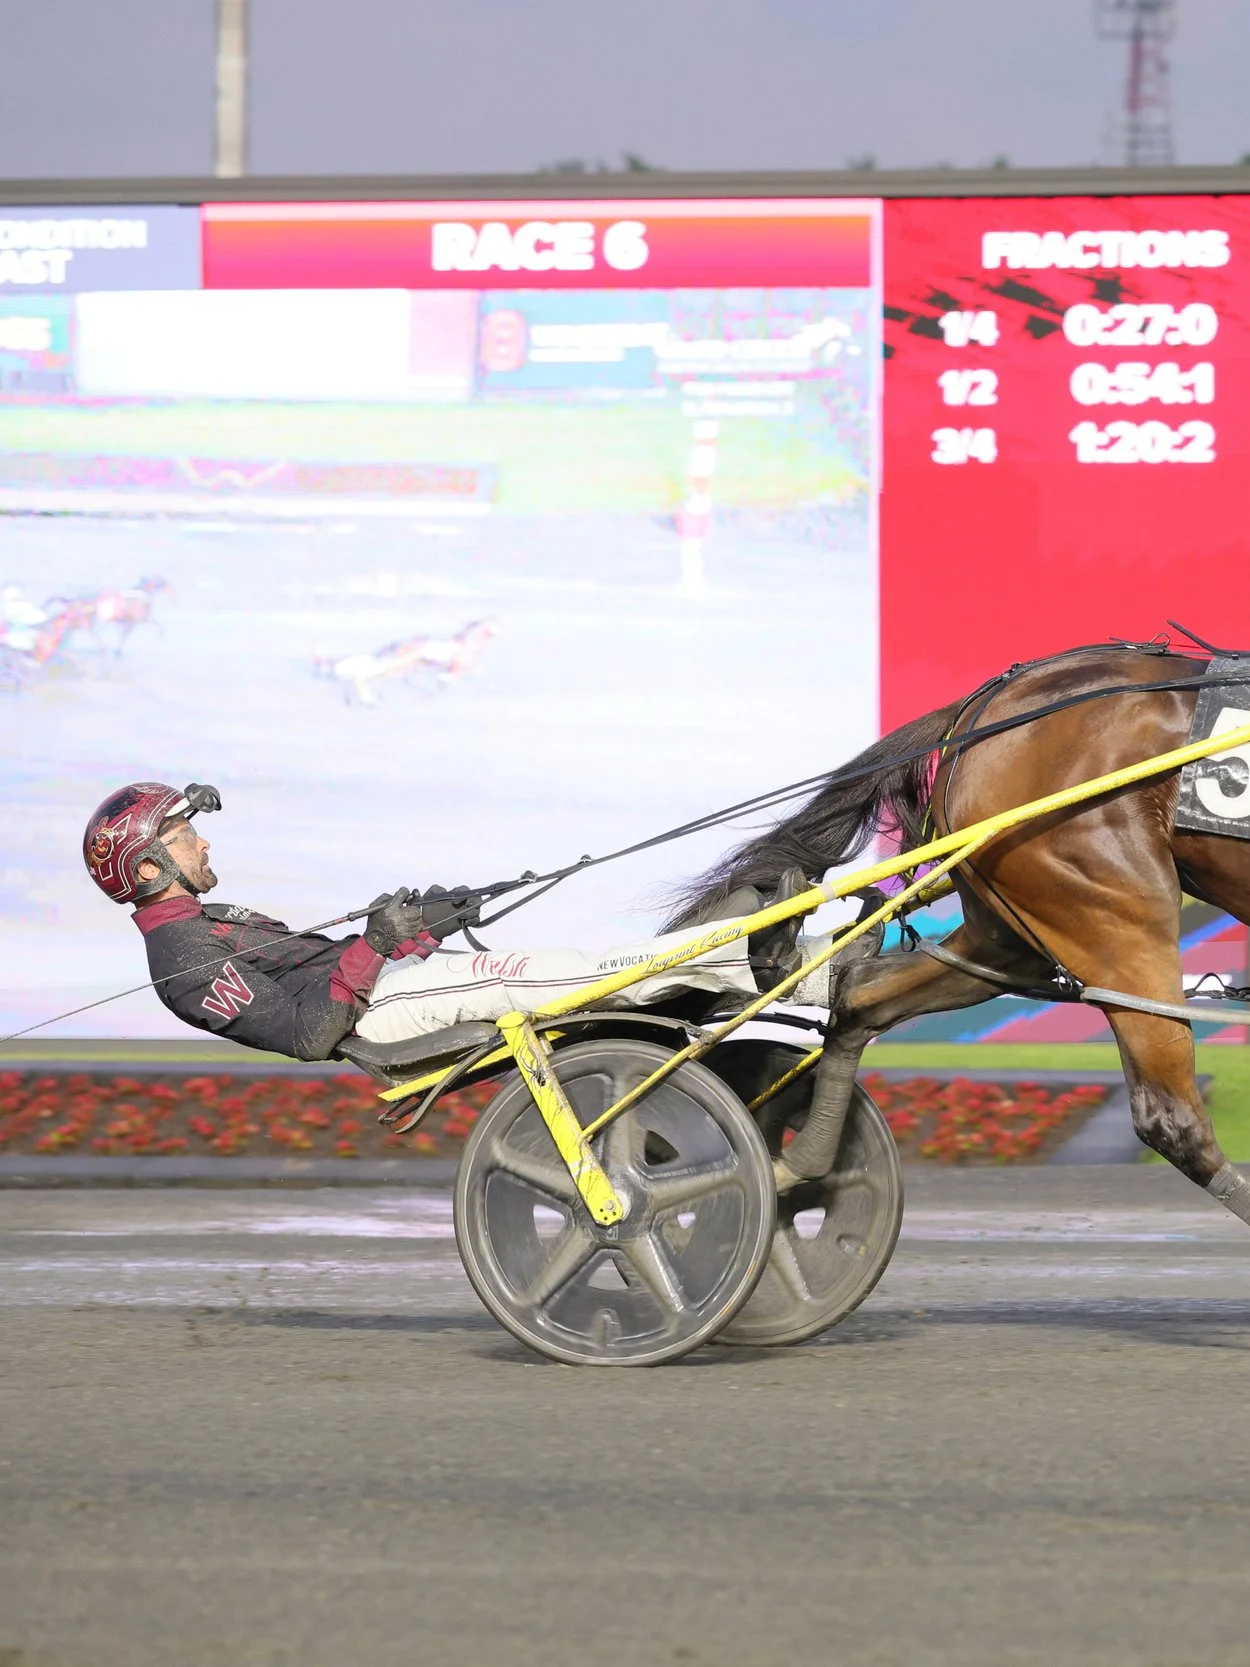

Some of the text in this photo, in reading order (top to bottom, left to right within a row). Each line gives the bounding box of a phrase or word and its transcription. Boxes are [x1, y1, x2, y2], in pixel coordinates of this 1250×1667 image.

[0, 219, 148, 250] ONDITION
[430, 220, 650, 271] RACE 6
[982, 230, 1231, 269] FRACTIONS
[0, 249, 74, 284] AST
[938, 304, 1219, 346] 1/4 0:27:0
[938, 362, 1215, 406] 1/2 0:54:1
[931, 421, 1216, 464] 3/4 1:20:2
[201, 960, 254, 1021] W
